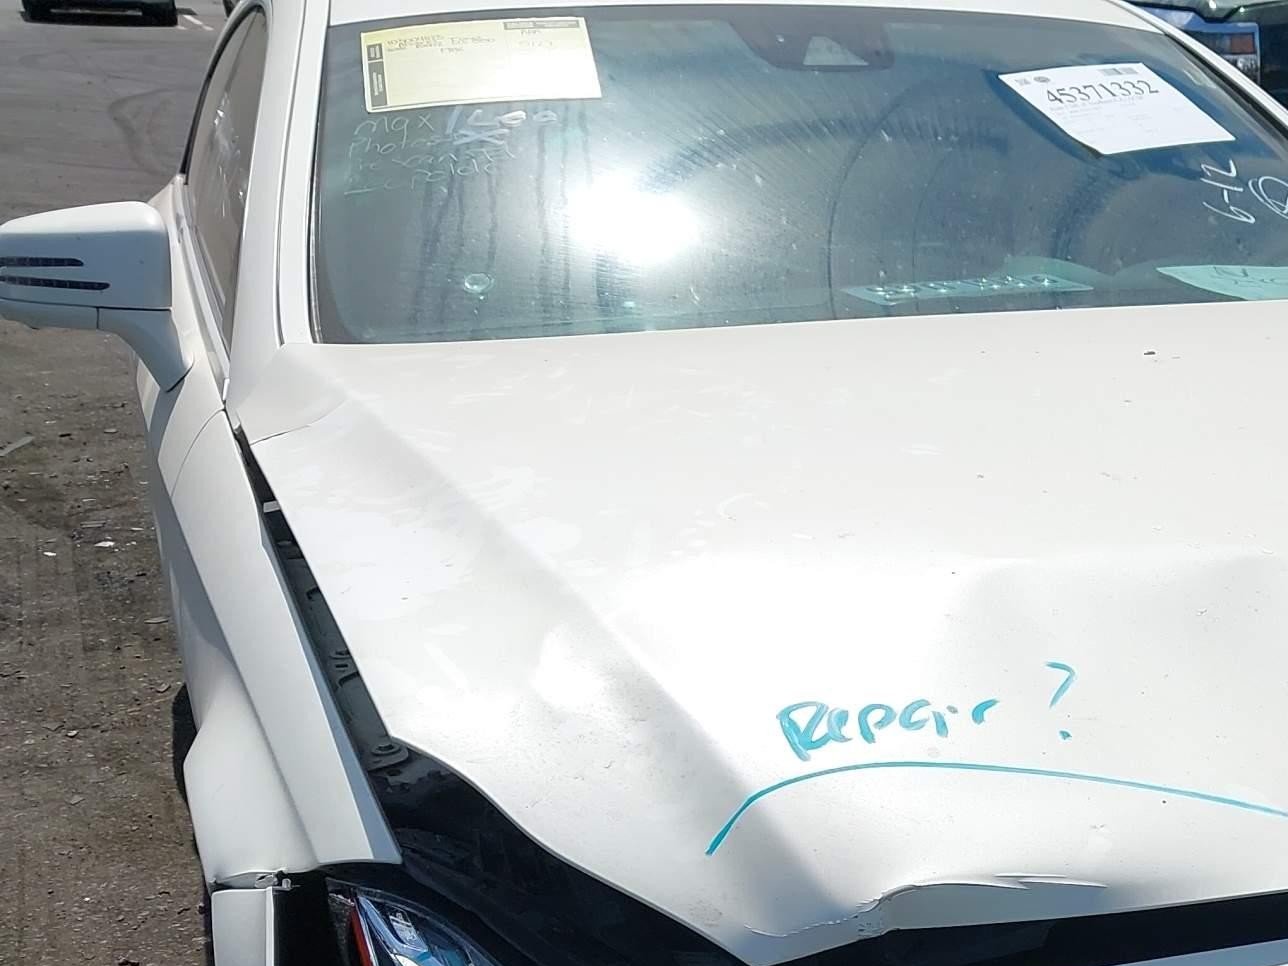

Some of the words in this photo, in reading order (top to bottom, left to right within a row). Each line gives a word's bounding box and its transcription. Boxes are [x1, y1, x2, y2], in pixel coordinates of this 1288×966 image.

[1044, 78, 1160, 105] 45371332
[1199, 158, 1256, 225] 6-12
[775, 697, 1001, 762] Repair
[1044, 660, 1078, 741] ?
